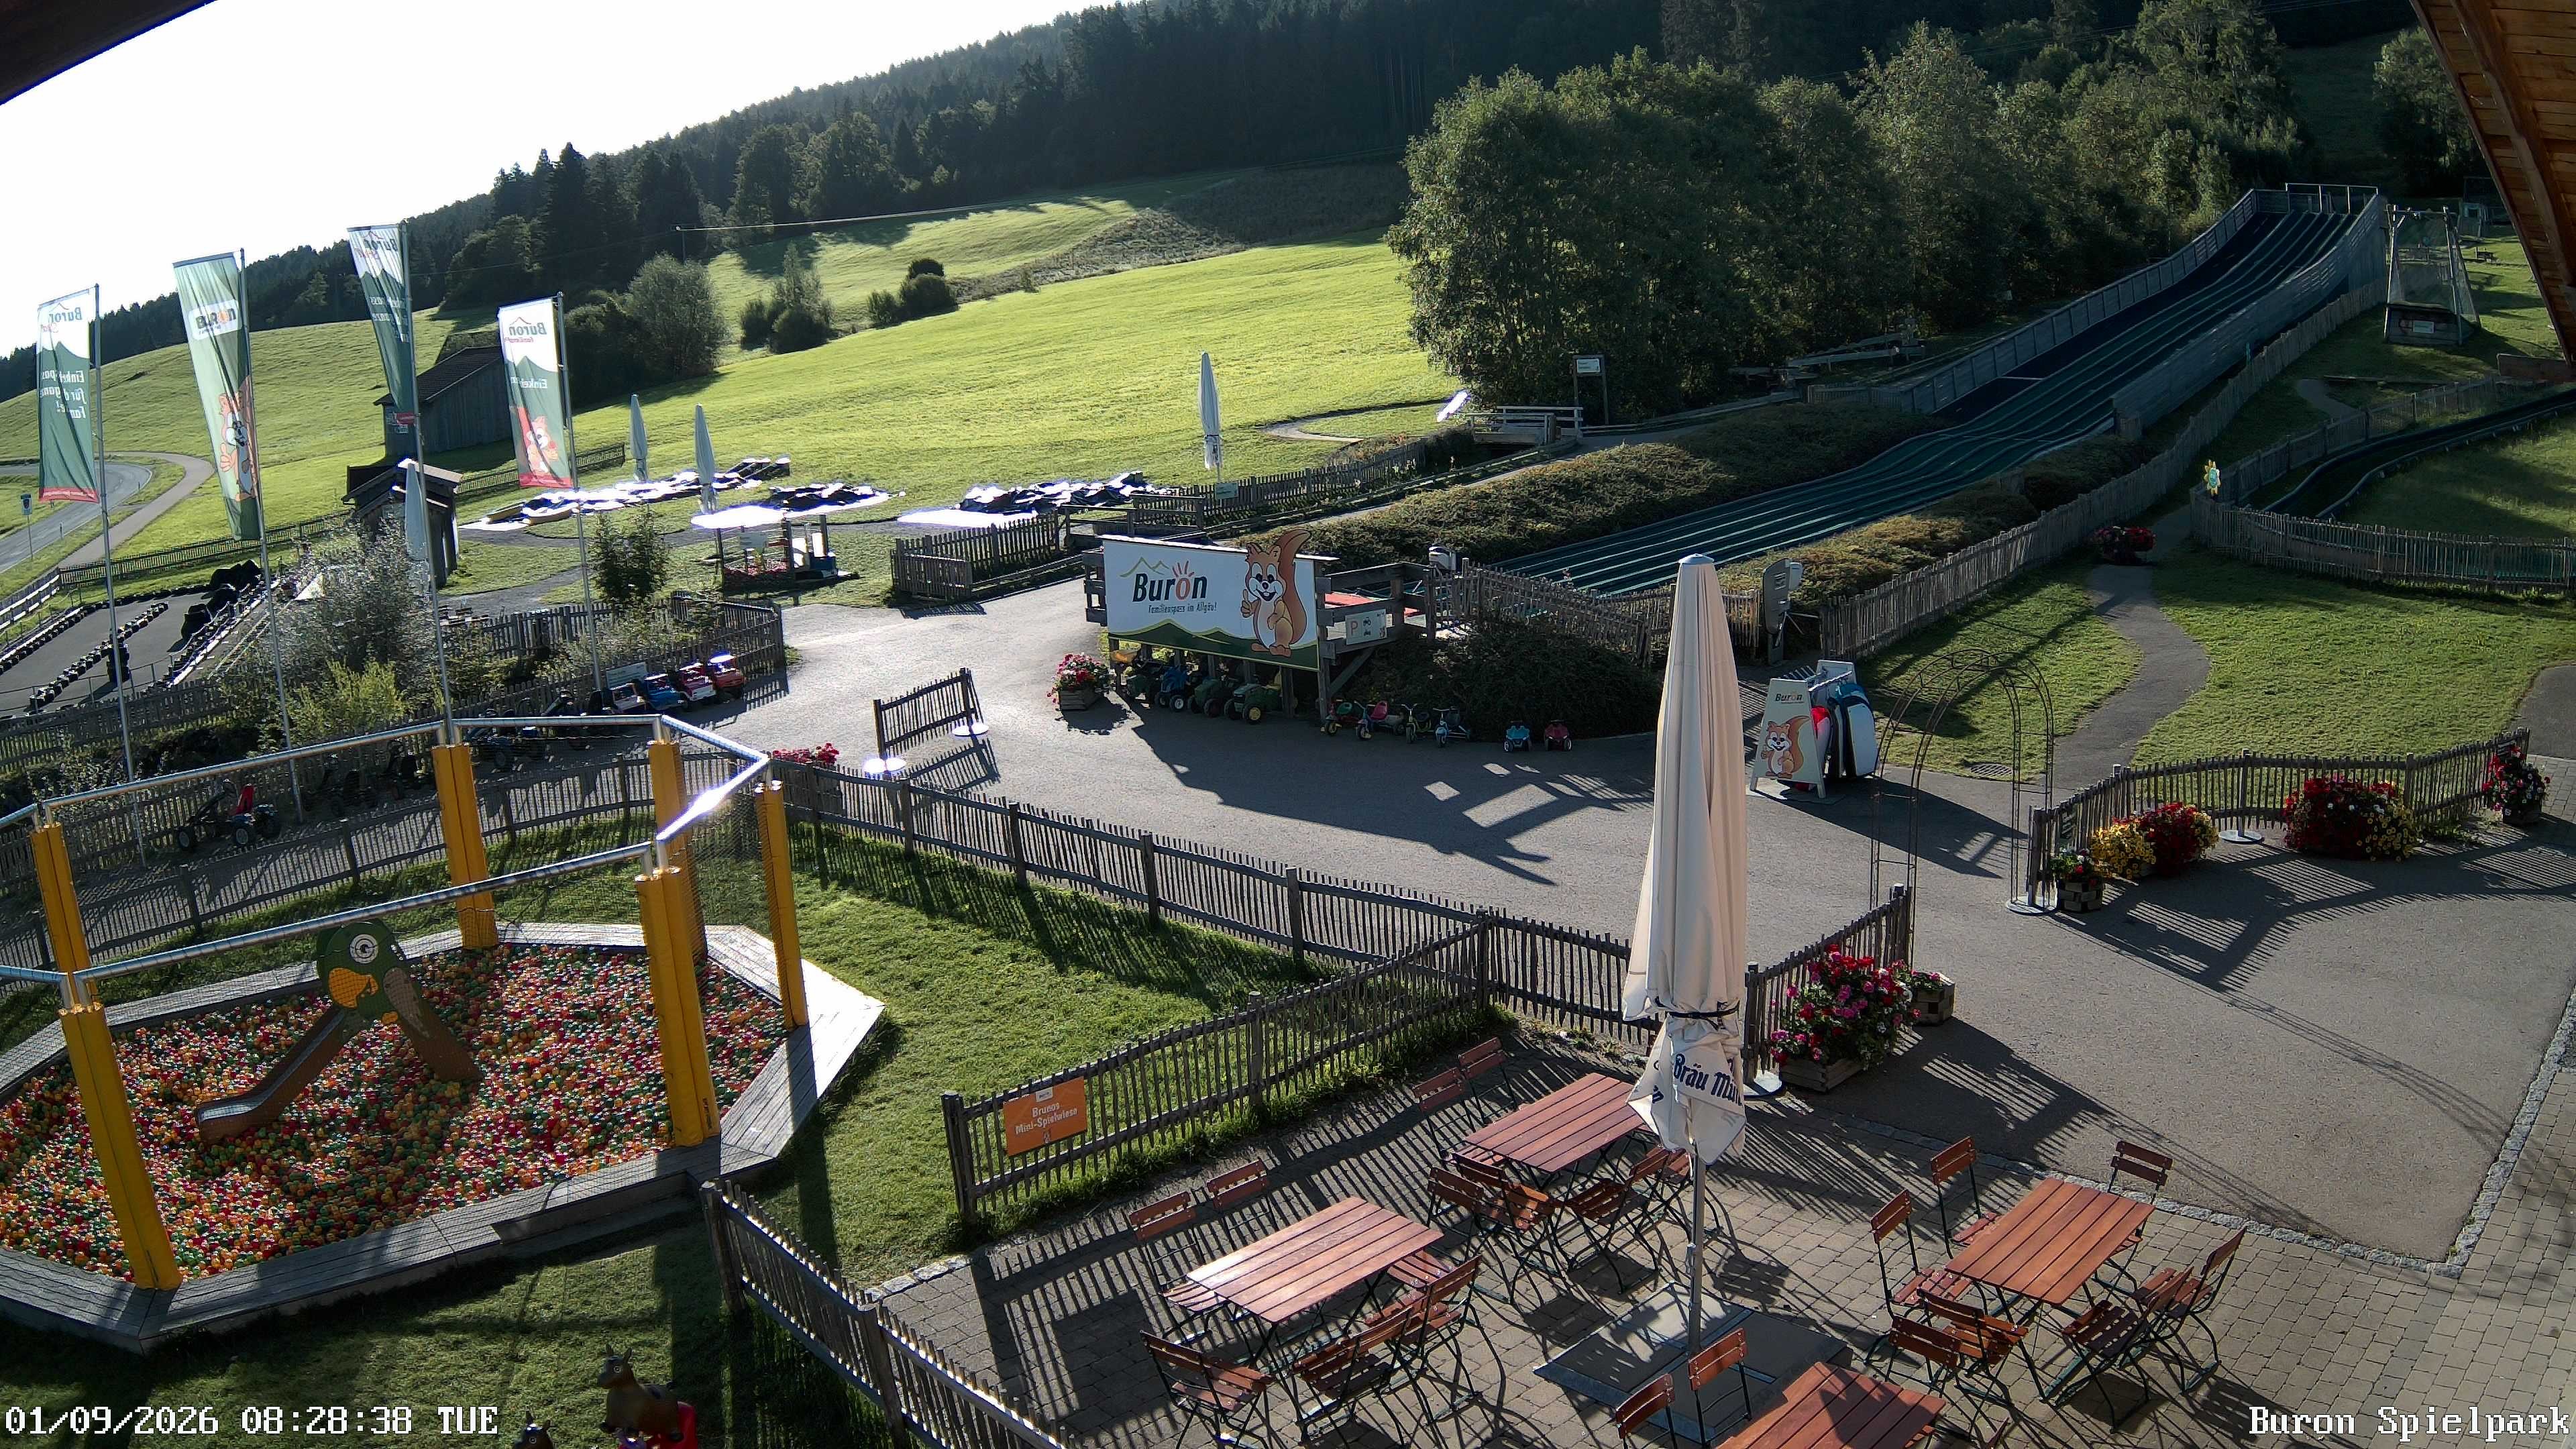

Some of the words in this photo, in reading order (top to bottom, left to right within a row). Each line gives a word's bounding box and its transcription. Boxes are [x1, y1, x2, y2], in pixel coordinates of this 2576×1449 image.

[1132, 572, 1208, 602] Buron
[1775, 693, 1803, 702] Buron
[1673, 1053, 1709, 1091] Bräu
[1032, 1102, 1061, 1118] Brunos
